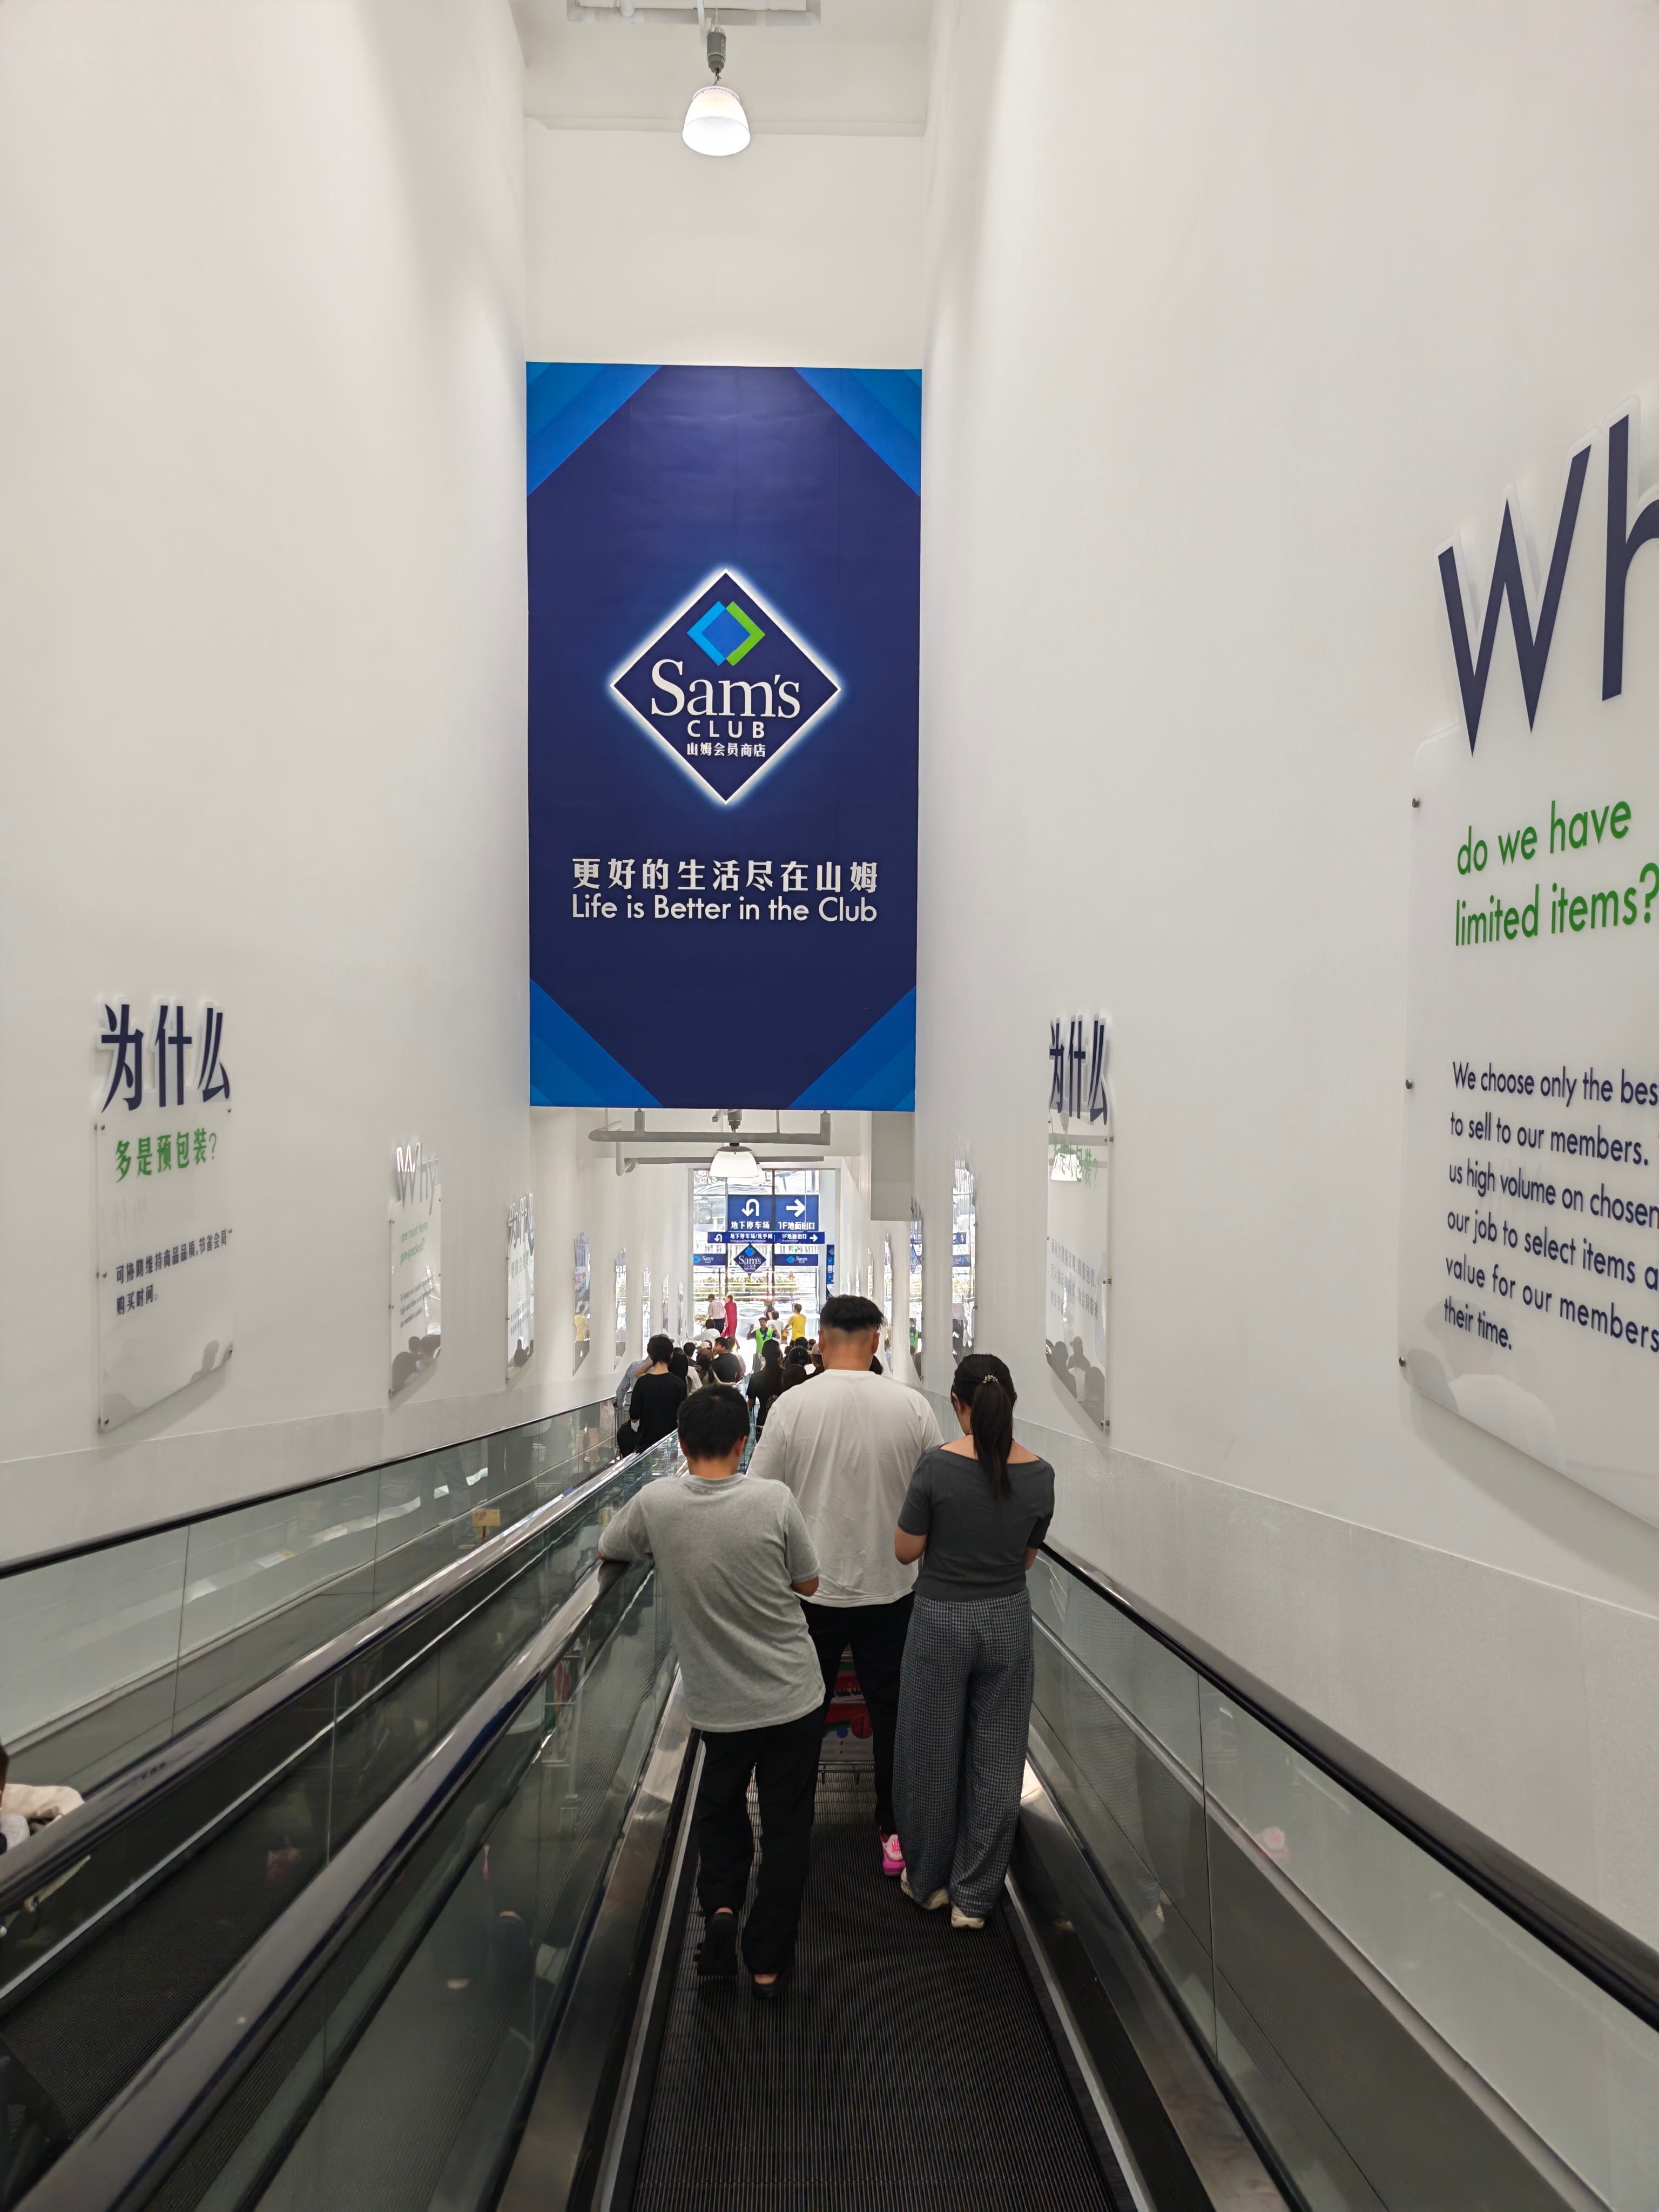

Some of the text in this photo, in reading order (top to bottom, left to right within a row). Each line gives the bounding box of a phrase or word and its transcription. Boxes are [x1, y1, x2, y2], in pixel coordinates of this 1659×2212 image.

[651, 659, 800, 718] Sam's
[687, 719, 765, 738] CLUB
[687, 742, 766, 757] 山姆会员商店
[1457, 800, 1631, 875] do we have
[572, 858, 878, 893] 更好的生活尽在山姆
[1455, 861, 1659, 945] limited items?
[572, 893, 877, 922] Life is Better in the Club
[101, 1004, 230, 1114] 为什么
[1049, 1020, 1108, 1125] 为什么
[1453, 1061, 1659, 1108] We choose only the bes
[115, 1127, 217, 1183] 多是预包装？
[1450, 1111, 1648, 1166] to sell to our members.
[398, 1143, 438, 1215] Why
[1449, 1158, 1659, 1230] us high volume on chosen
[731, 1221, 770, 1230] 地下停车场
[778, 1222, 815, 1230] 1F地面出口
[1447, 1211, 1470, 1233] our
[1472, 1209, 1498, 1244] job
[1502, 1220, 1518, 1248] to
[1524, 1226, 1576, 1265] select
[1582, 1238, 1635, 1284] items
[738, 1255, 761, 1264] Sam's
[116, 1284, 158, 1316] 购买时间。
[1444, 1296, 1512, 1350] their time.
[1446, 1253, 1659, 1353] value for our members
